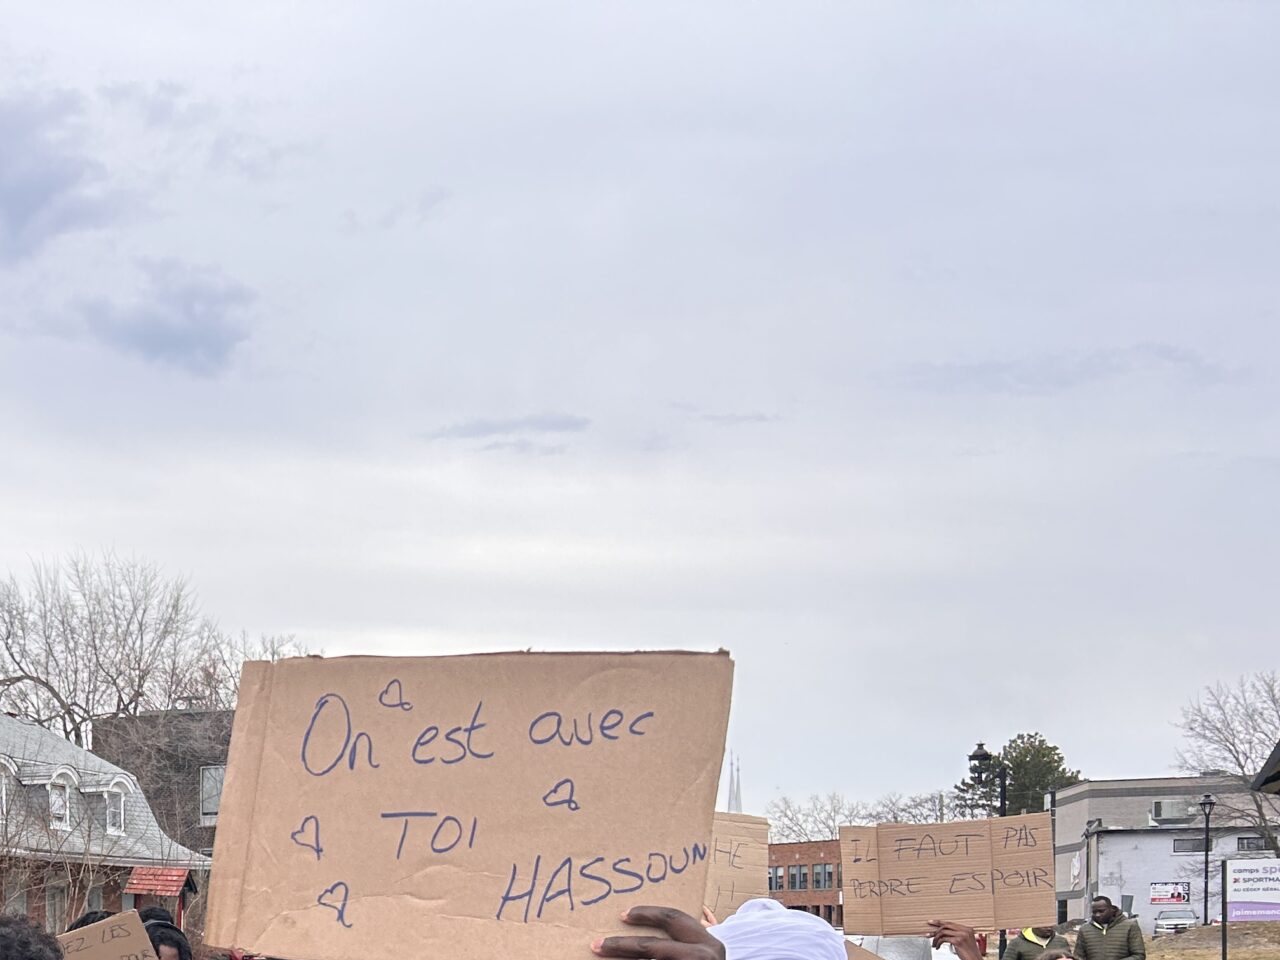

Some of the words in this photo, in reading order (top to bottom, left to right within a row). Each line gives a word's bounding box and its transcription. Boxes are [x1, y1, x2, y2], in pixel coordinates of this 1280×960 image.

[301, 693, 379, 776] On
[412, 702, 493, 764] est
[529, 709, 653, 746] avec
[382, 812, 477, 859] TOI
[851, 839, 877, 863] IL
[894, 833, 984, 860] FAUT
[1003, 824, 1039, 849] PAS
[497, 843, 707, 922] HASSOUN
[851, 877, 928, 898] PERDRE
[949, 868, 1054, 895] ESPOIR
[101, 923, 131, 943] LES
